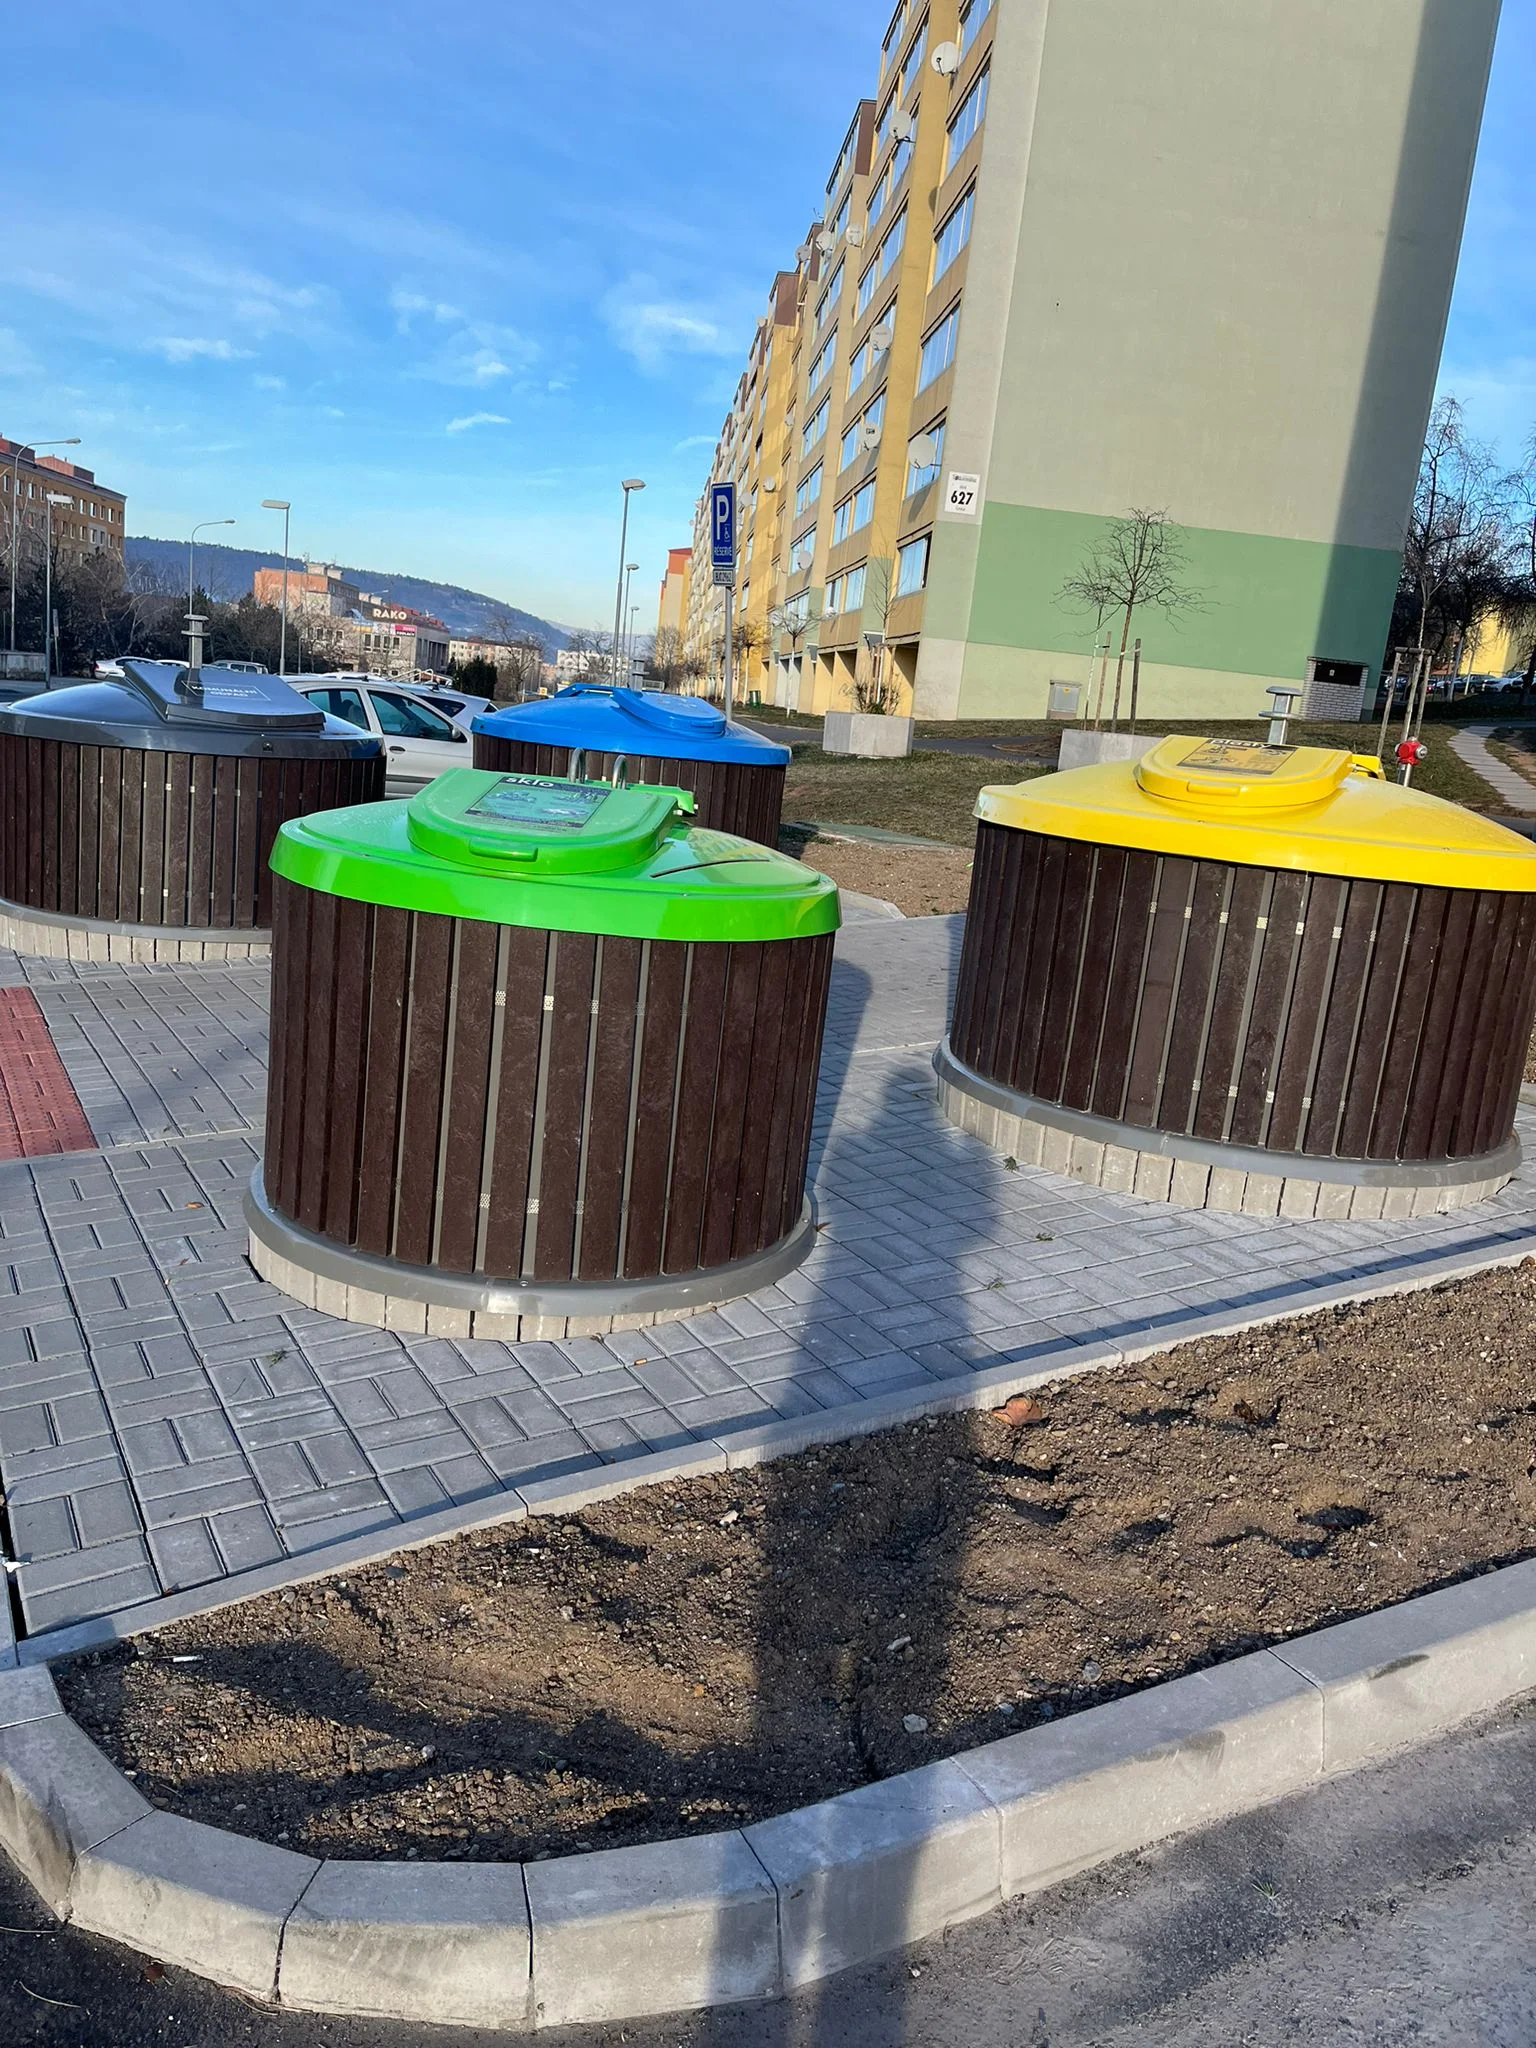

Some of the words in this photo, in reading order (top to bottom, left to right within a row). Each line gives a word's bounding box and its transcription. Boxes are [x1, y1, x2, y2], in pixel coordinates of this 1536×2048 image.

[951, 490, 974, 505] 627
[716, 495, 730, 540] P
[373, 608, 407, 620] RAKO
[505, 776, 554, 787] sklo
